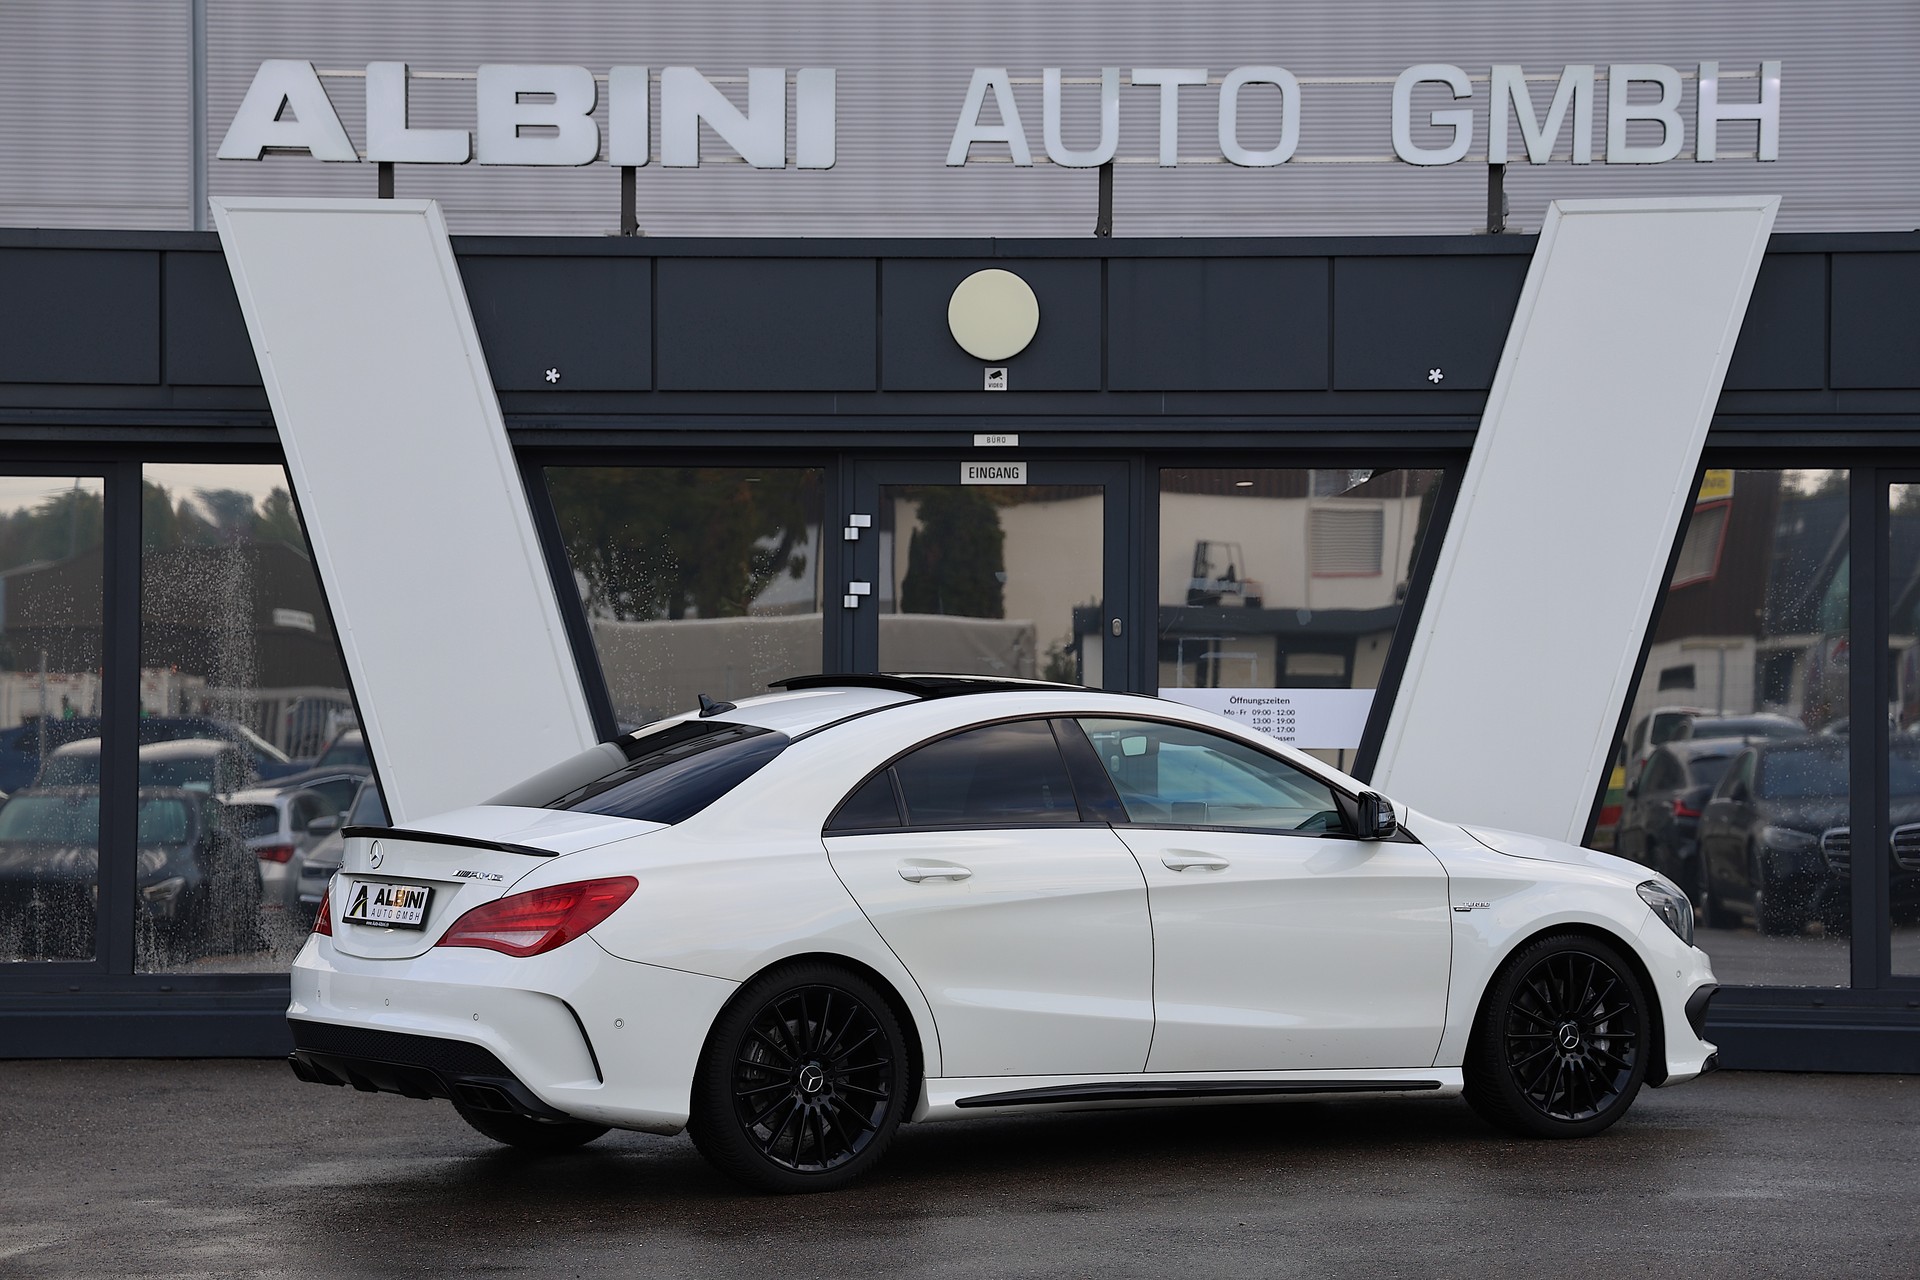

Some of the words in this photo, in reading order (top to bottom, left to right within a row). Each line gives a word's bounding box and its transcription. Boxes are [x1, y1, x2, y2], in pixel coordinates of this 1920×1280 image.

[216, 59, 836, 170] ALBINI
[946, 65, 1301, 168] AUTO
[1390, 60, 1782, 167] GMBH
[968, 466, 1019, 479] EINGANG
[1229, 695, 1290, 705] Öffnungszeiten
[374, 888, 425, 909] ALBINI
[370, 908, 393, 919] AUTO
[395, 910, 421, 921] GMBH
